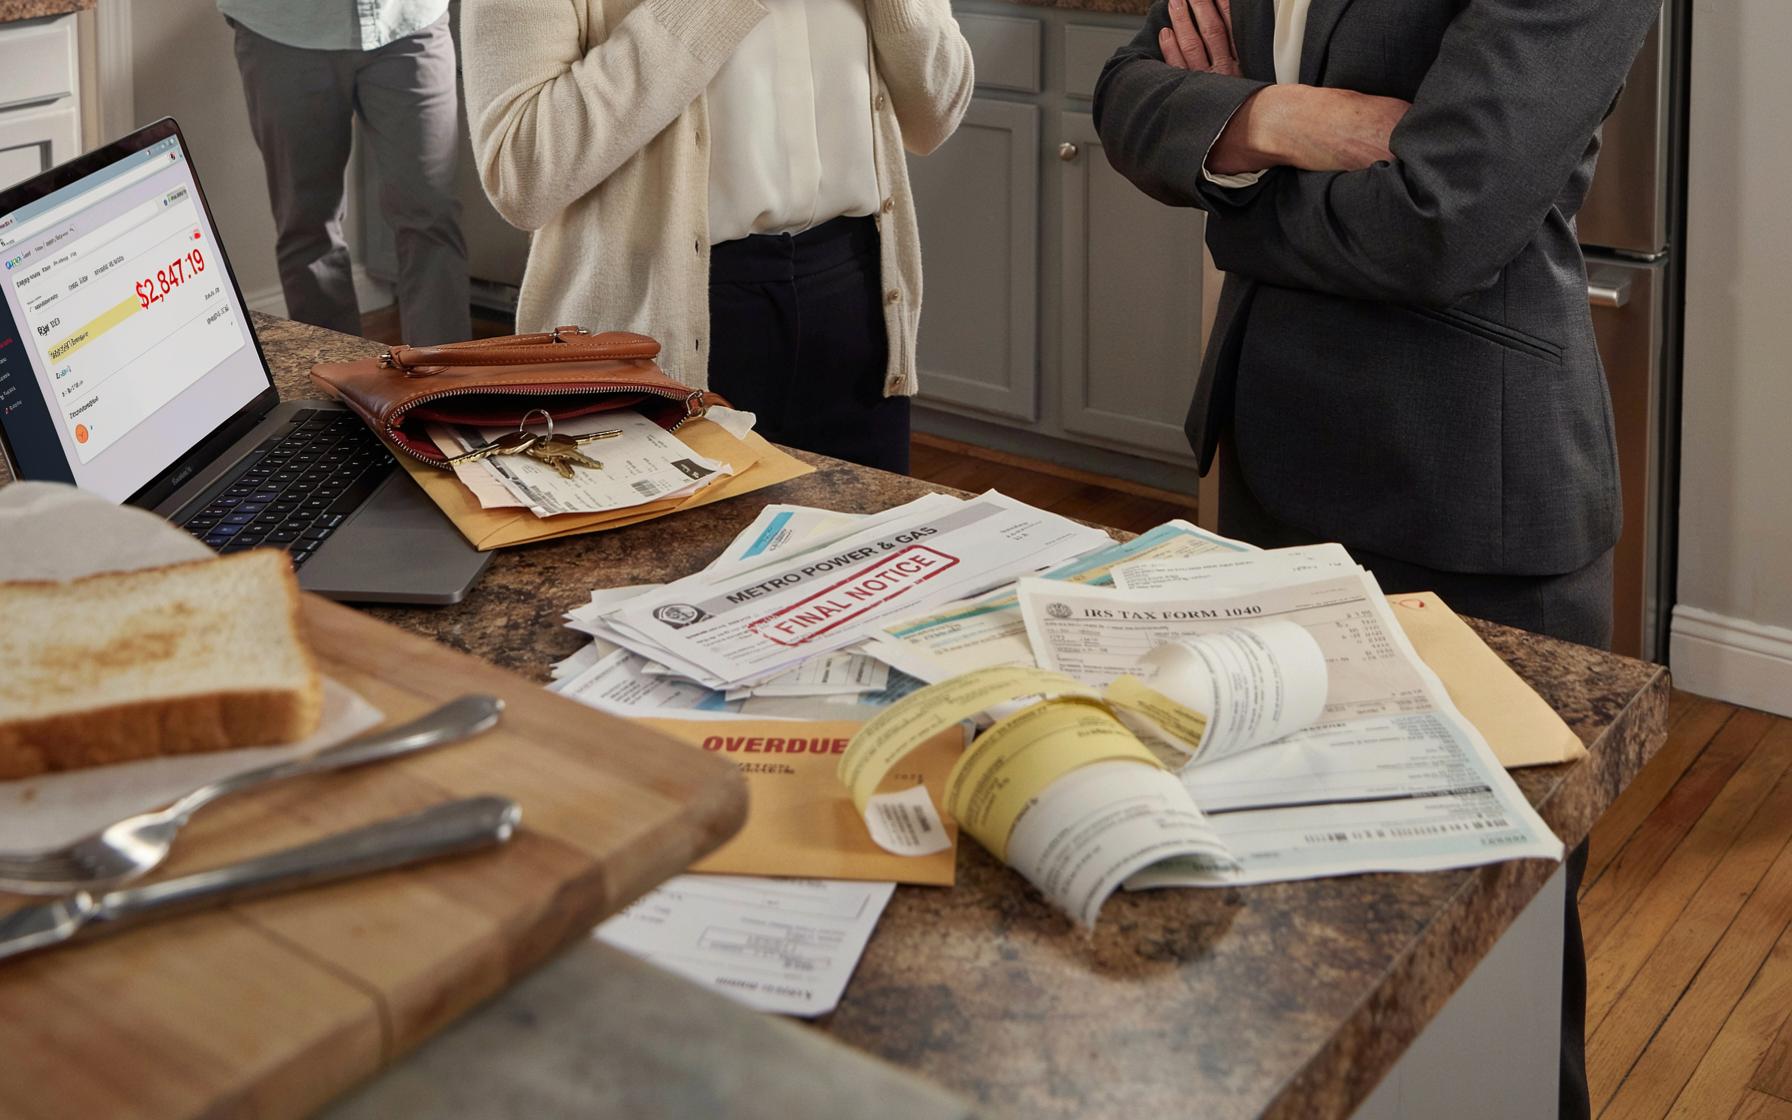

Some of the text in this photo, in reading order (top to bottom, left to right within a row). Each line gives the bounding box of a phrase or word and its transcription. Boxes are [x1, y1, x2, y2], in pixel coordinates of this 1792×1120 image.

[135, 248, 205, 310] $2,847.19
[726, 526, 938, 604] METRO POWER & GAS
[774, 600, 853, 635] FINAL
[844, 555, 936, 601] NOTICE
[1084, 605, 1262, 620] IRS TAX FORM 1040
[702, 736, 850, 755] OVERDUE
